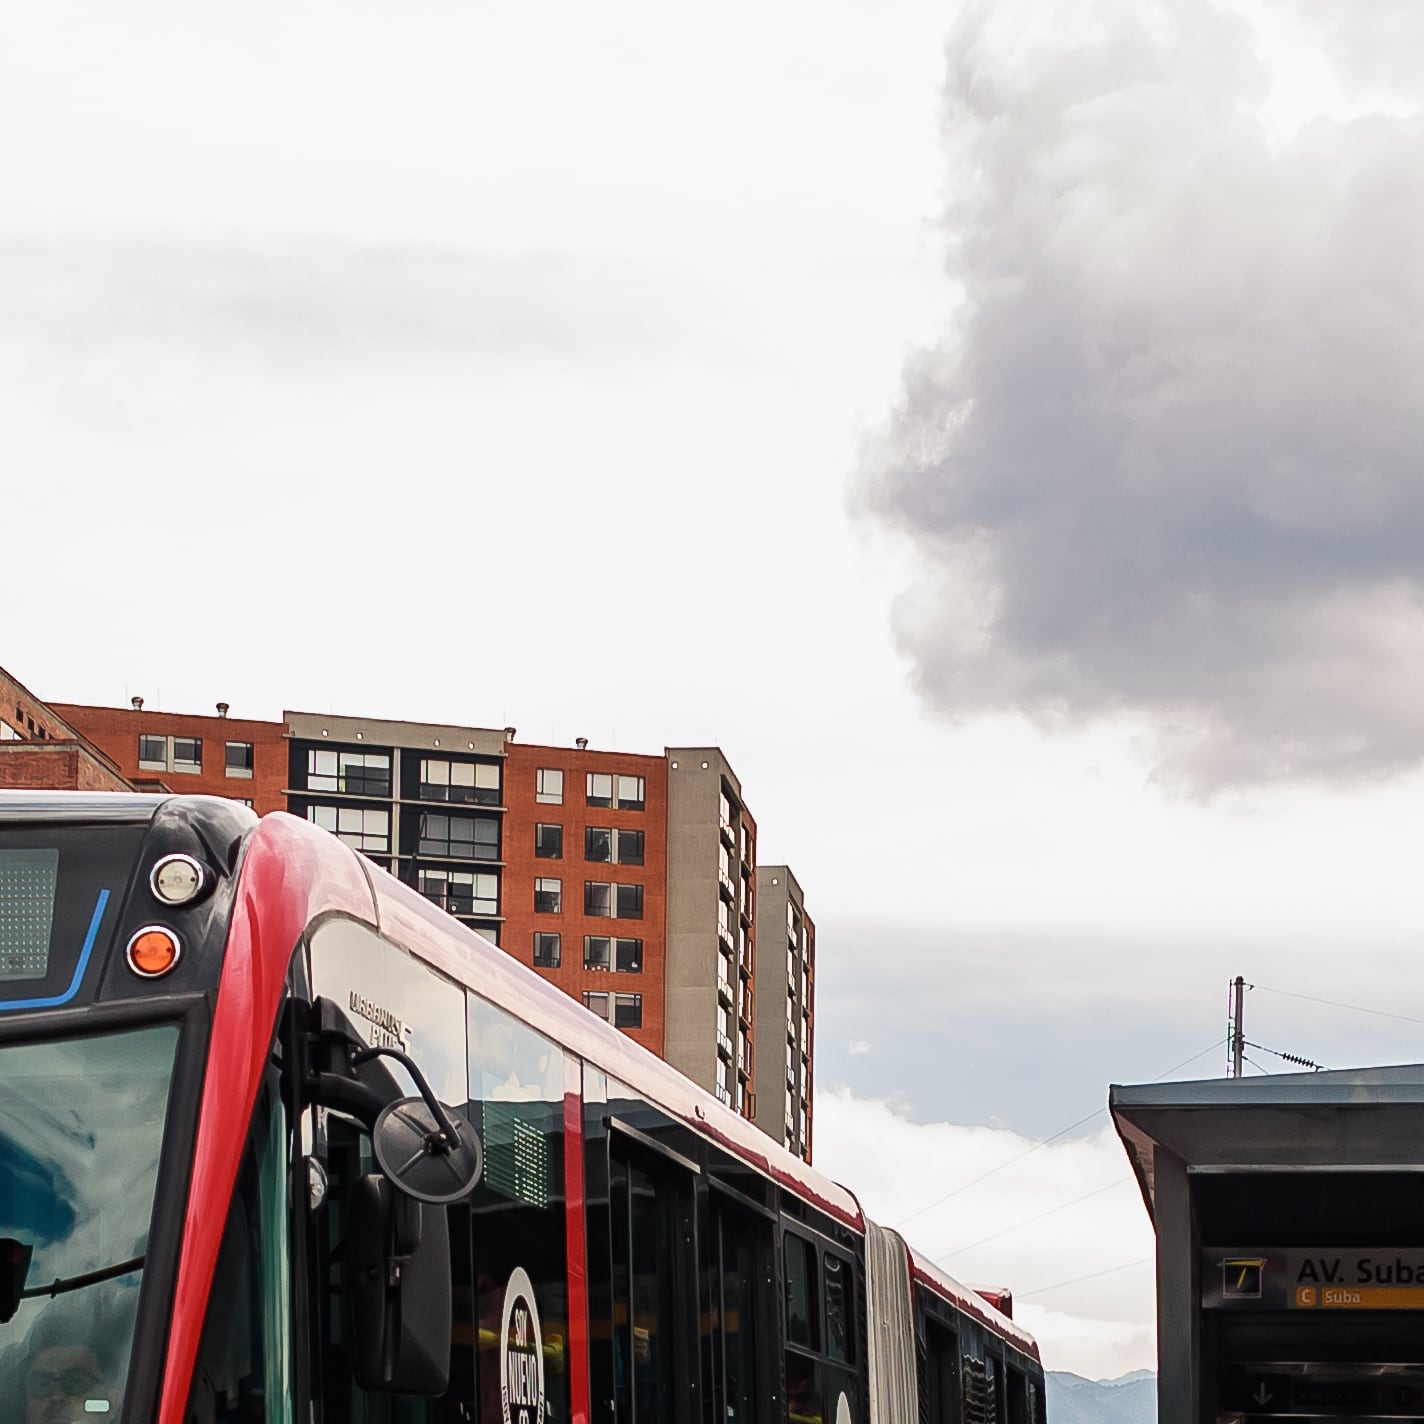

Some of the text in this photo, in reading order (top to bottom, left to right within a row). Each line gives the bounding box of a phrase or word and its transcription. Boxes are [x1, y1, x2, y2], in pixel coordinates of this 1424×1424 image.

[1296, 1258, 1345, 1284] AV.
[1325, 1289, 1362, 1304] Suba
[508, 1351, 538, 1407] NUEVO
